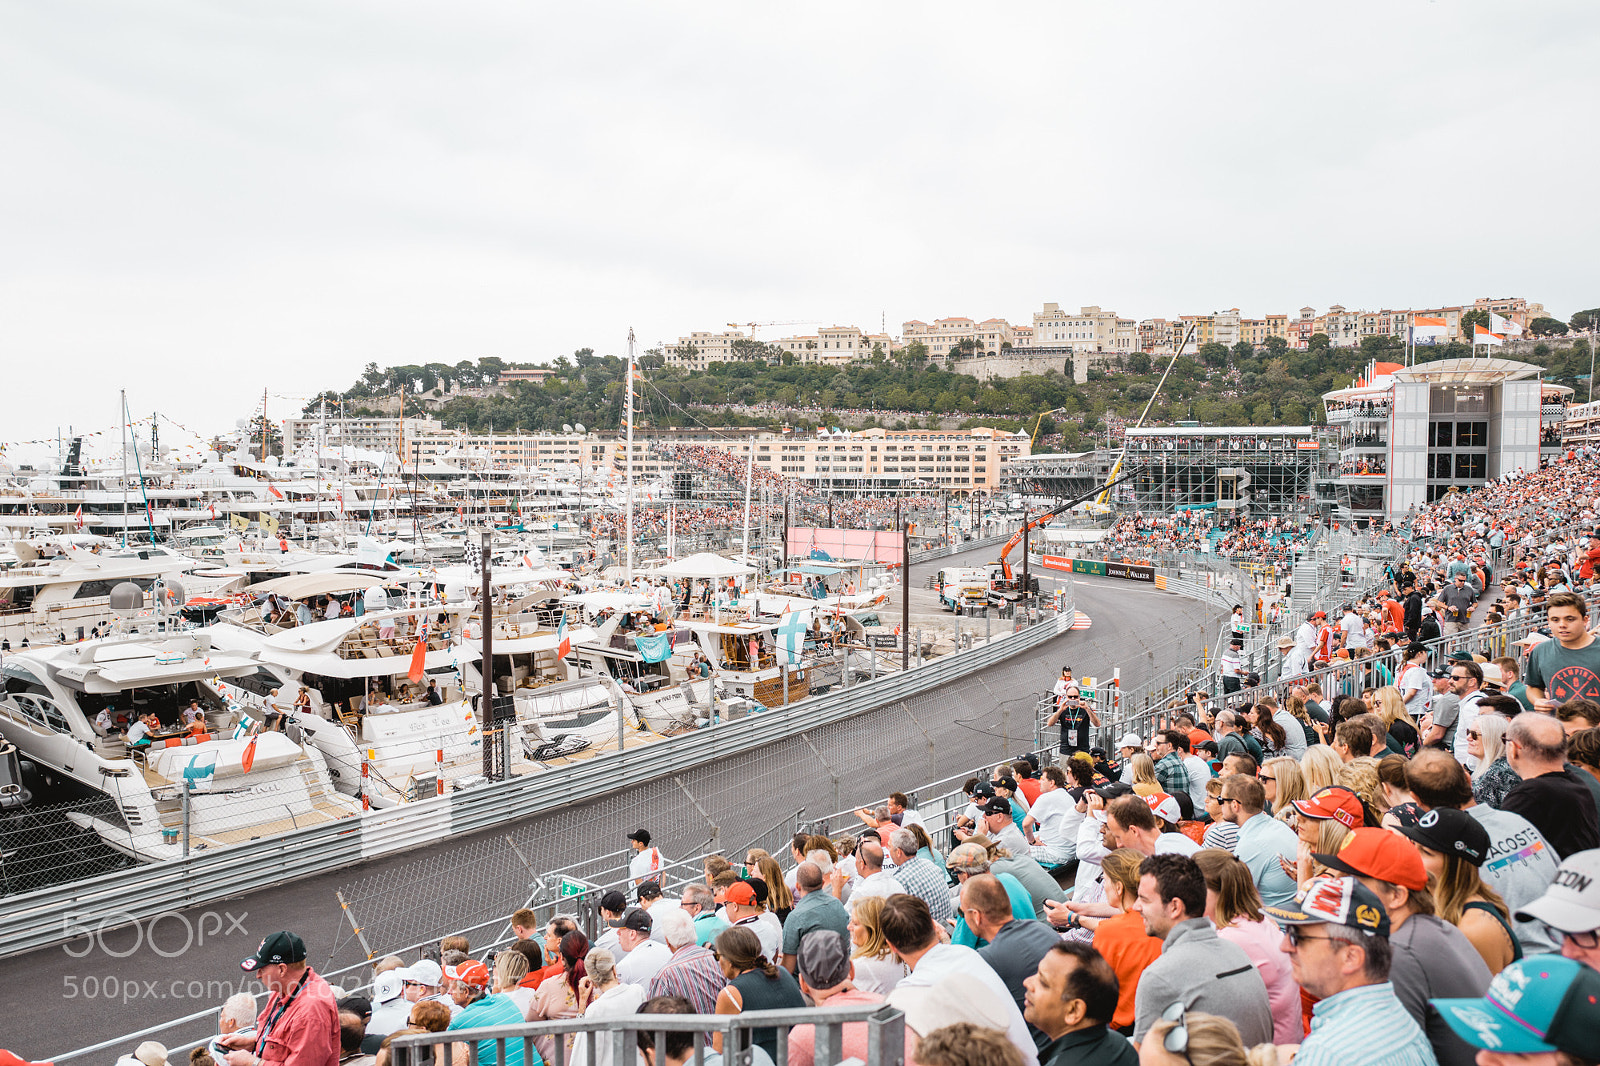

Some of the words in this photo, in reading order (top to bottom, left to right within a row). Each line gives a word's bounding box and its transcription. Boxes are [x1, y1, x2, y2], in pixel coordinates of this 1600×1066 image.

[1108, 568, 1126, 577] JOHNNIE
[1130, 570, 1150, 579] WALKER
[1556, 668, 1594, 681] CAMPING
[1310, 877, 1344, 917] MONAC
